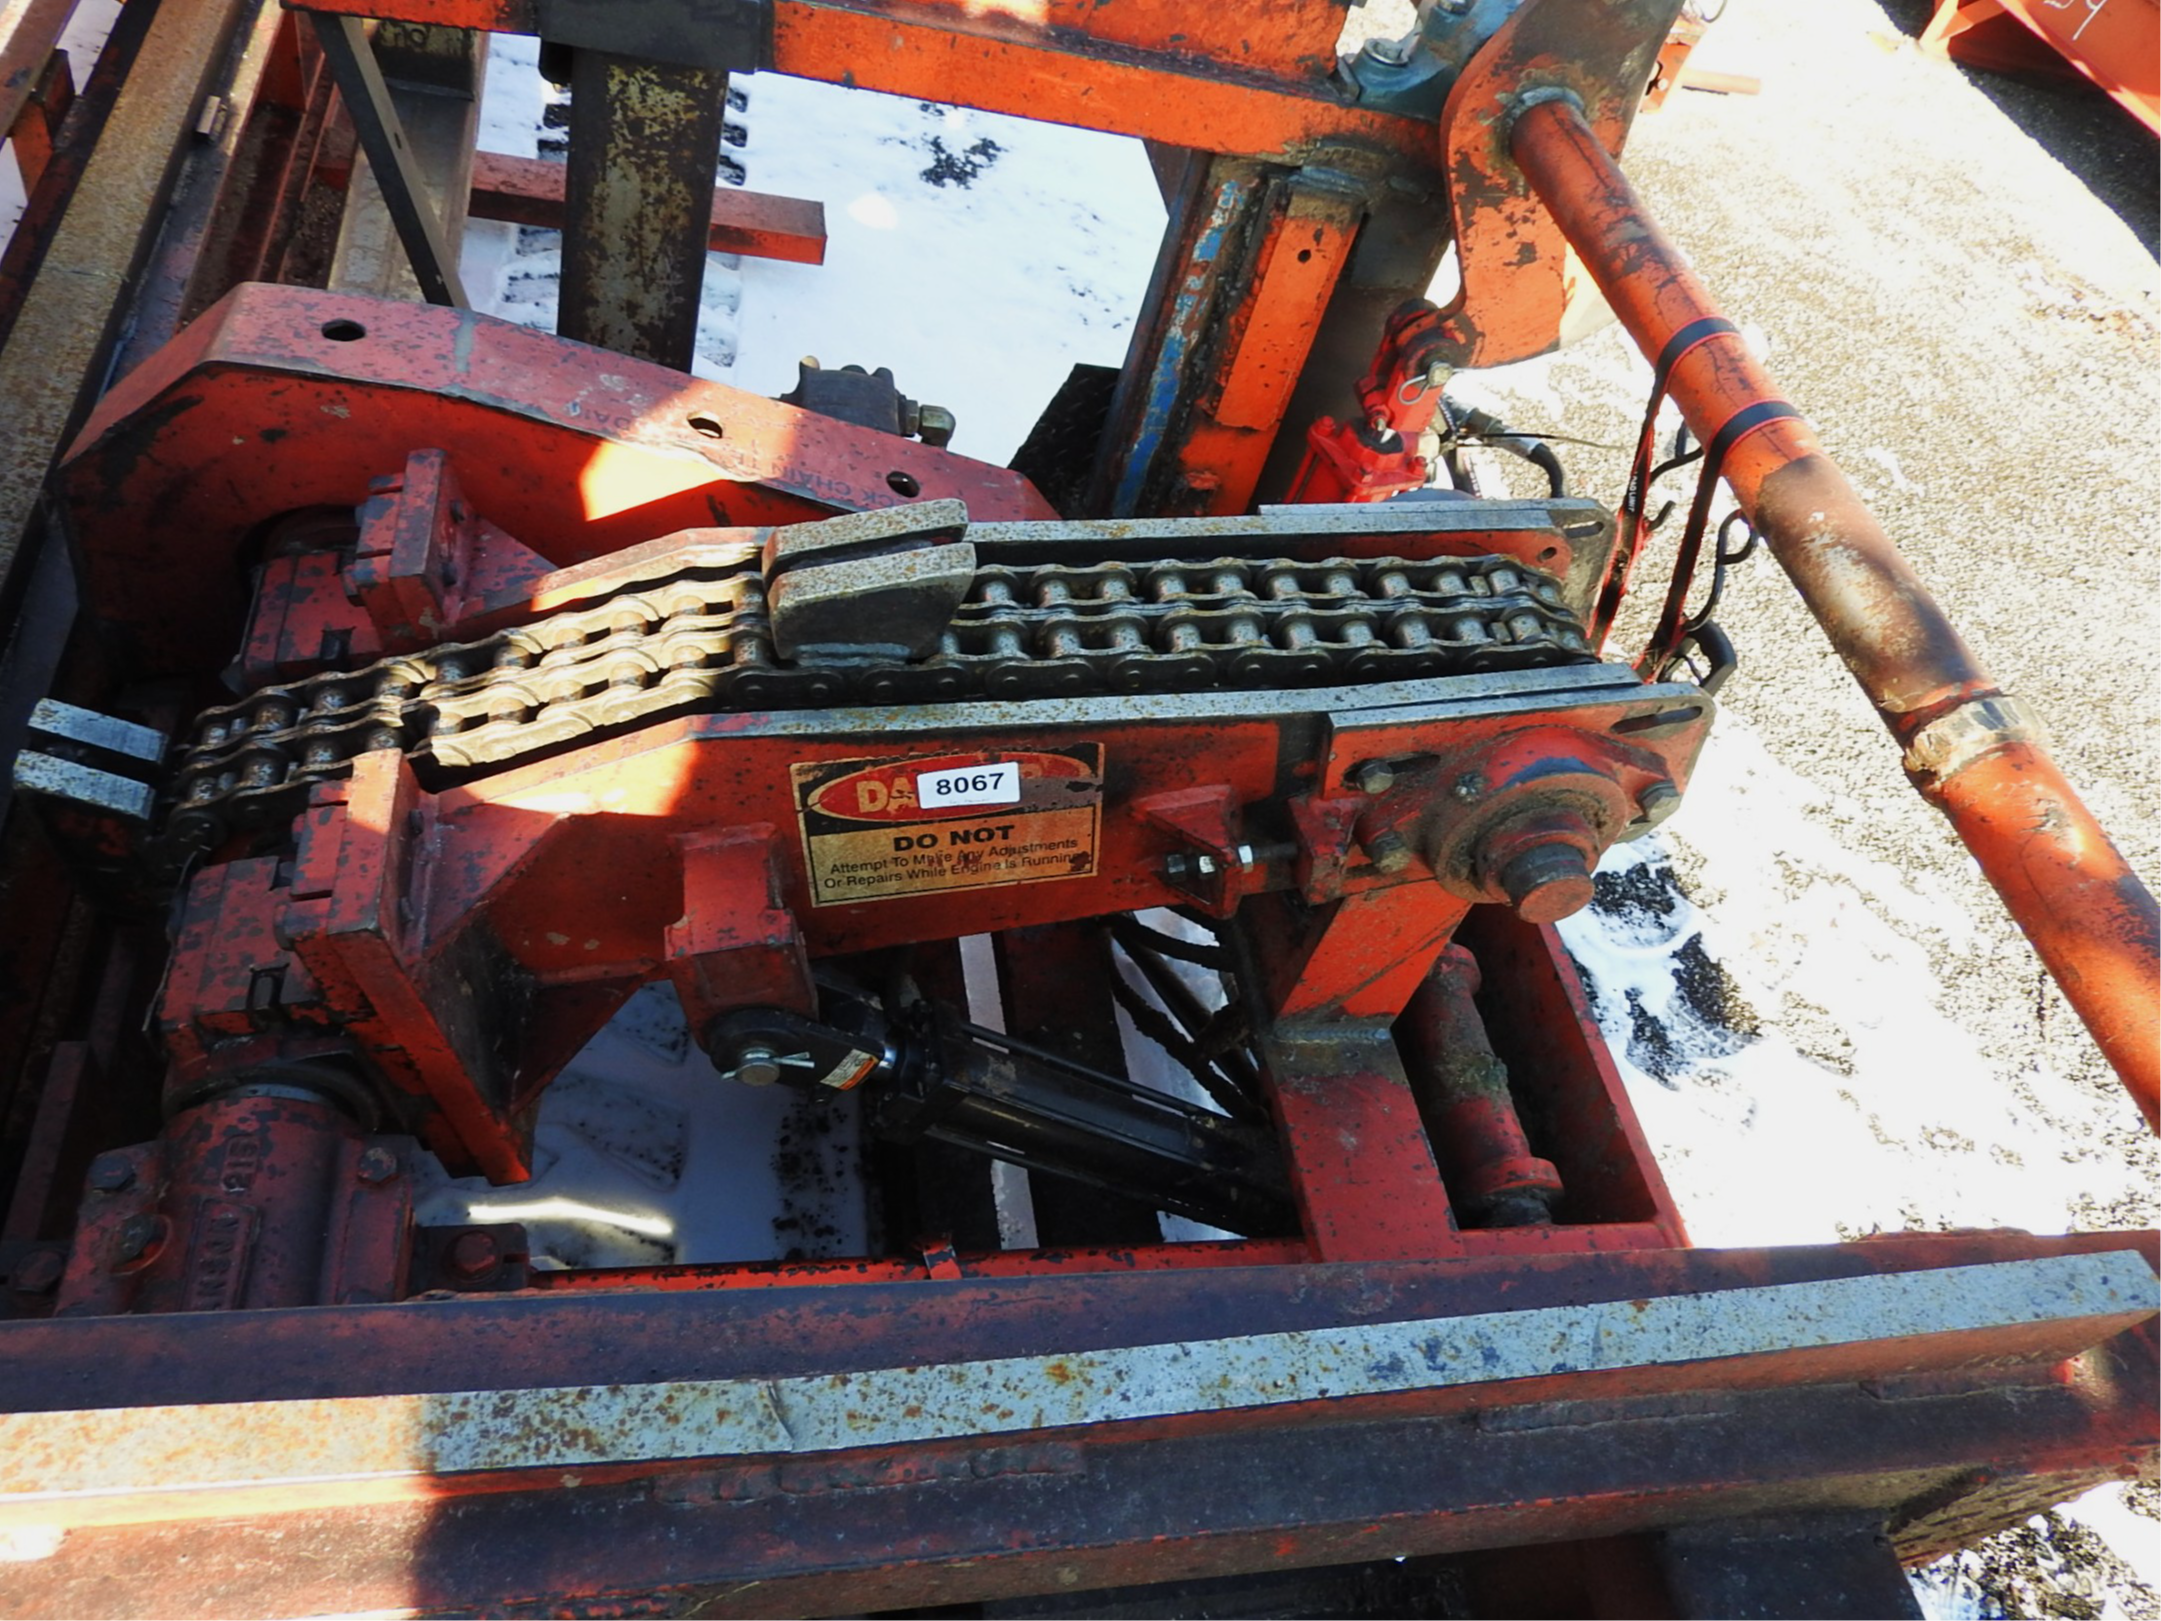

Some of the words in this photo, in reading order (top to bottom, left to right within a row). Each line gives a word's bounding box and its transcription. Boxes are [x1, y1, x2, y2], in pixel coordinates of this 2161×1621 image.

[936, 772, 1004, 796] 8067
[893, 833, 939, 851] DO
[950, 825, 1015, 846] NOT
[824, 877, 842, 889] Or
[847, 871, 902, 887] Repairs
[906, 867, 946, 880] While
[951, 860, 1001, 876] Engine
[1005, 858, 1016, 870] Is
[1021, 851, 1083, 867] Runnin
[830, 859, 888, 875] Attempt
[891, 857, 909, 868] To
[957, 849, 984, 862] Any
[988, 839, 1078, 858] Adjustments
